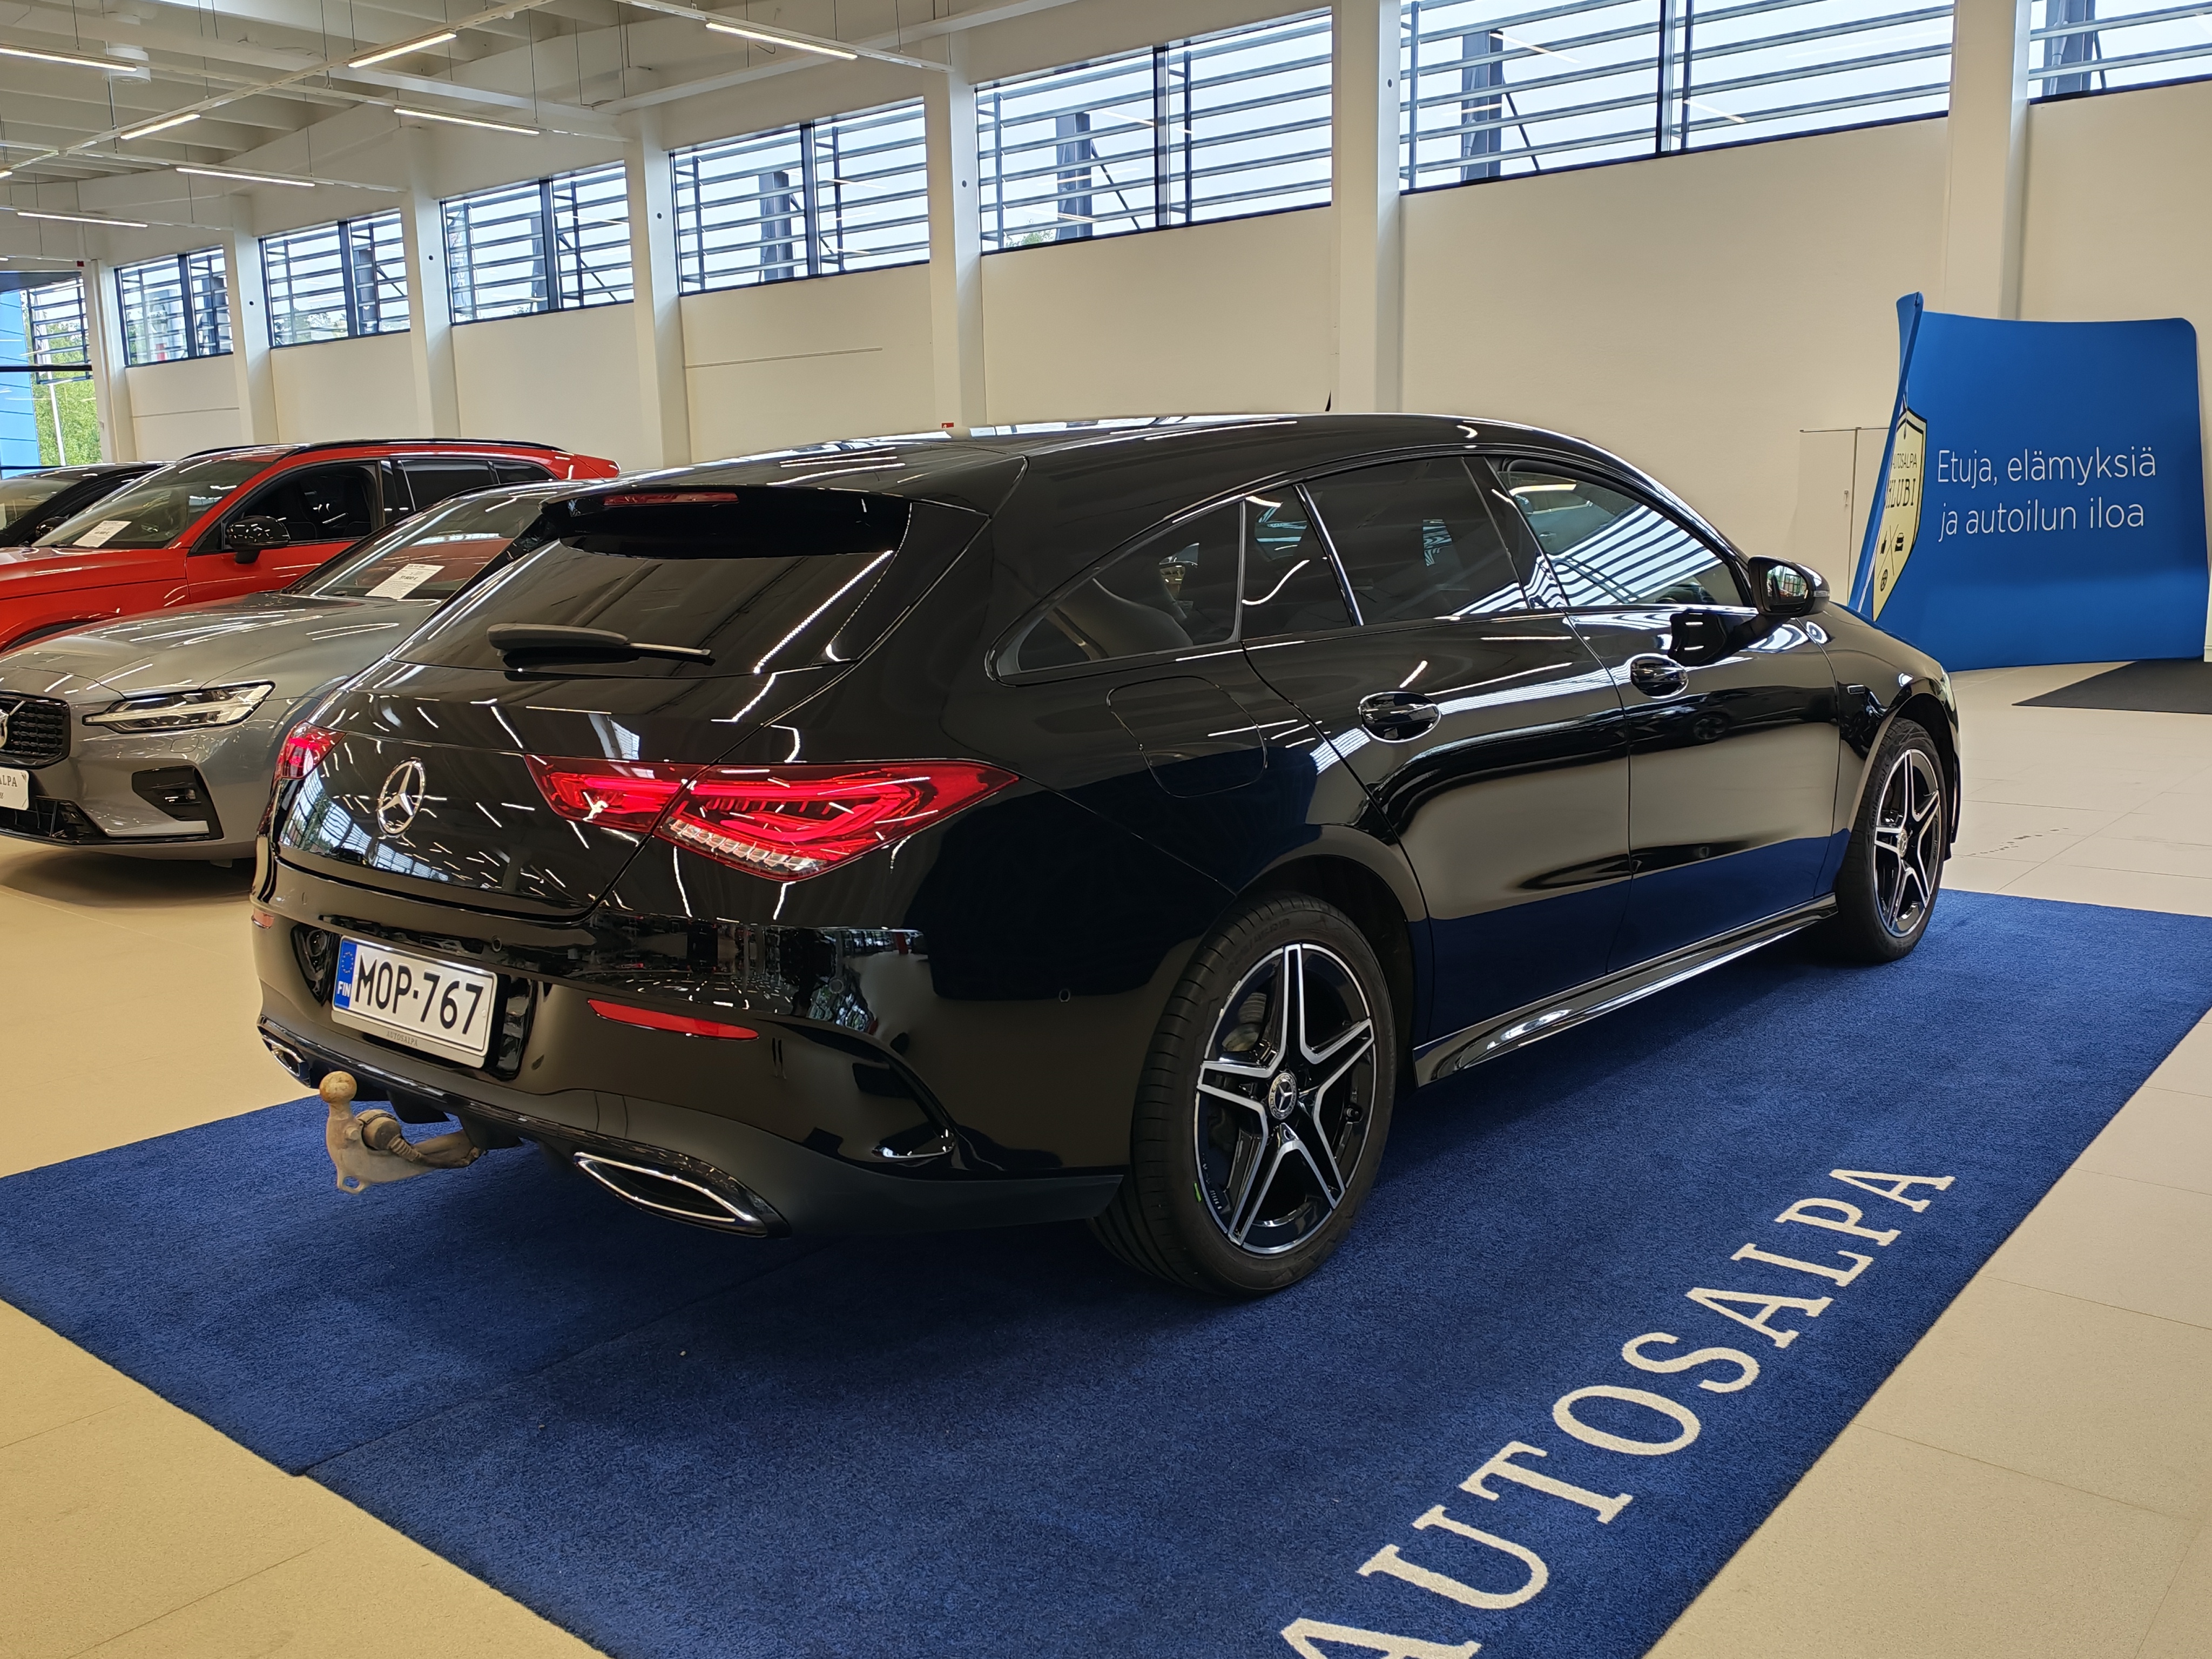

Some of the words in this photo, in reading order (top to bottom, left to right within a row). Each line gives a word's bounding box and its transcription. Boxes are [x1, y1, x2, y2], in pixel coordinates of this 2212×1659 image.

[1938, 449, 1997, 489] Etuja,
[2008, 446, 2156, 485] elämyksiä
[1938, 502, 1958, 542] ja
[1966, 498, 2076, 535] autoilun
[2090, 496, 2144, 528] iloa
[337, 980, 351, 997] FIN
[355, 954, 484, 1035] MOP-767
[386, 1030, 418, 1047] AUTOSALPA
